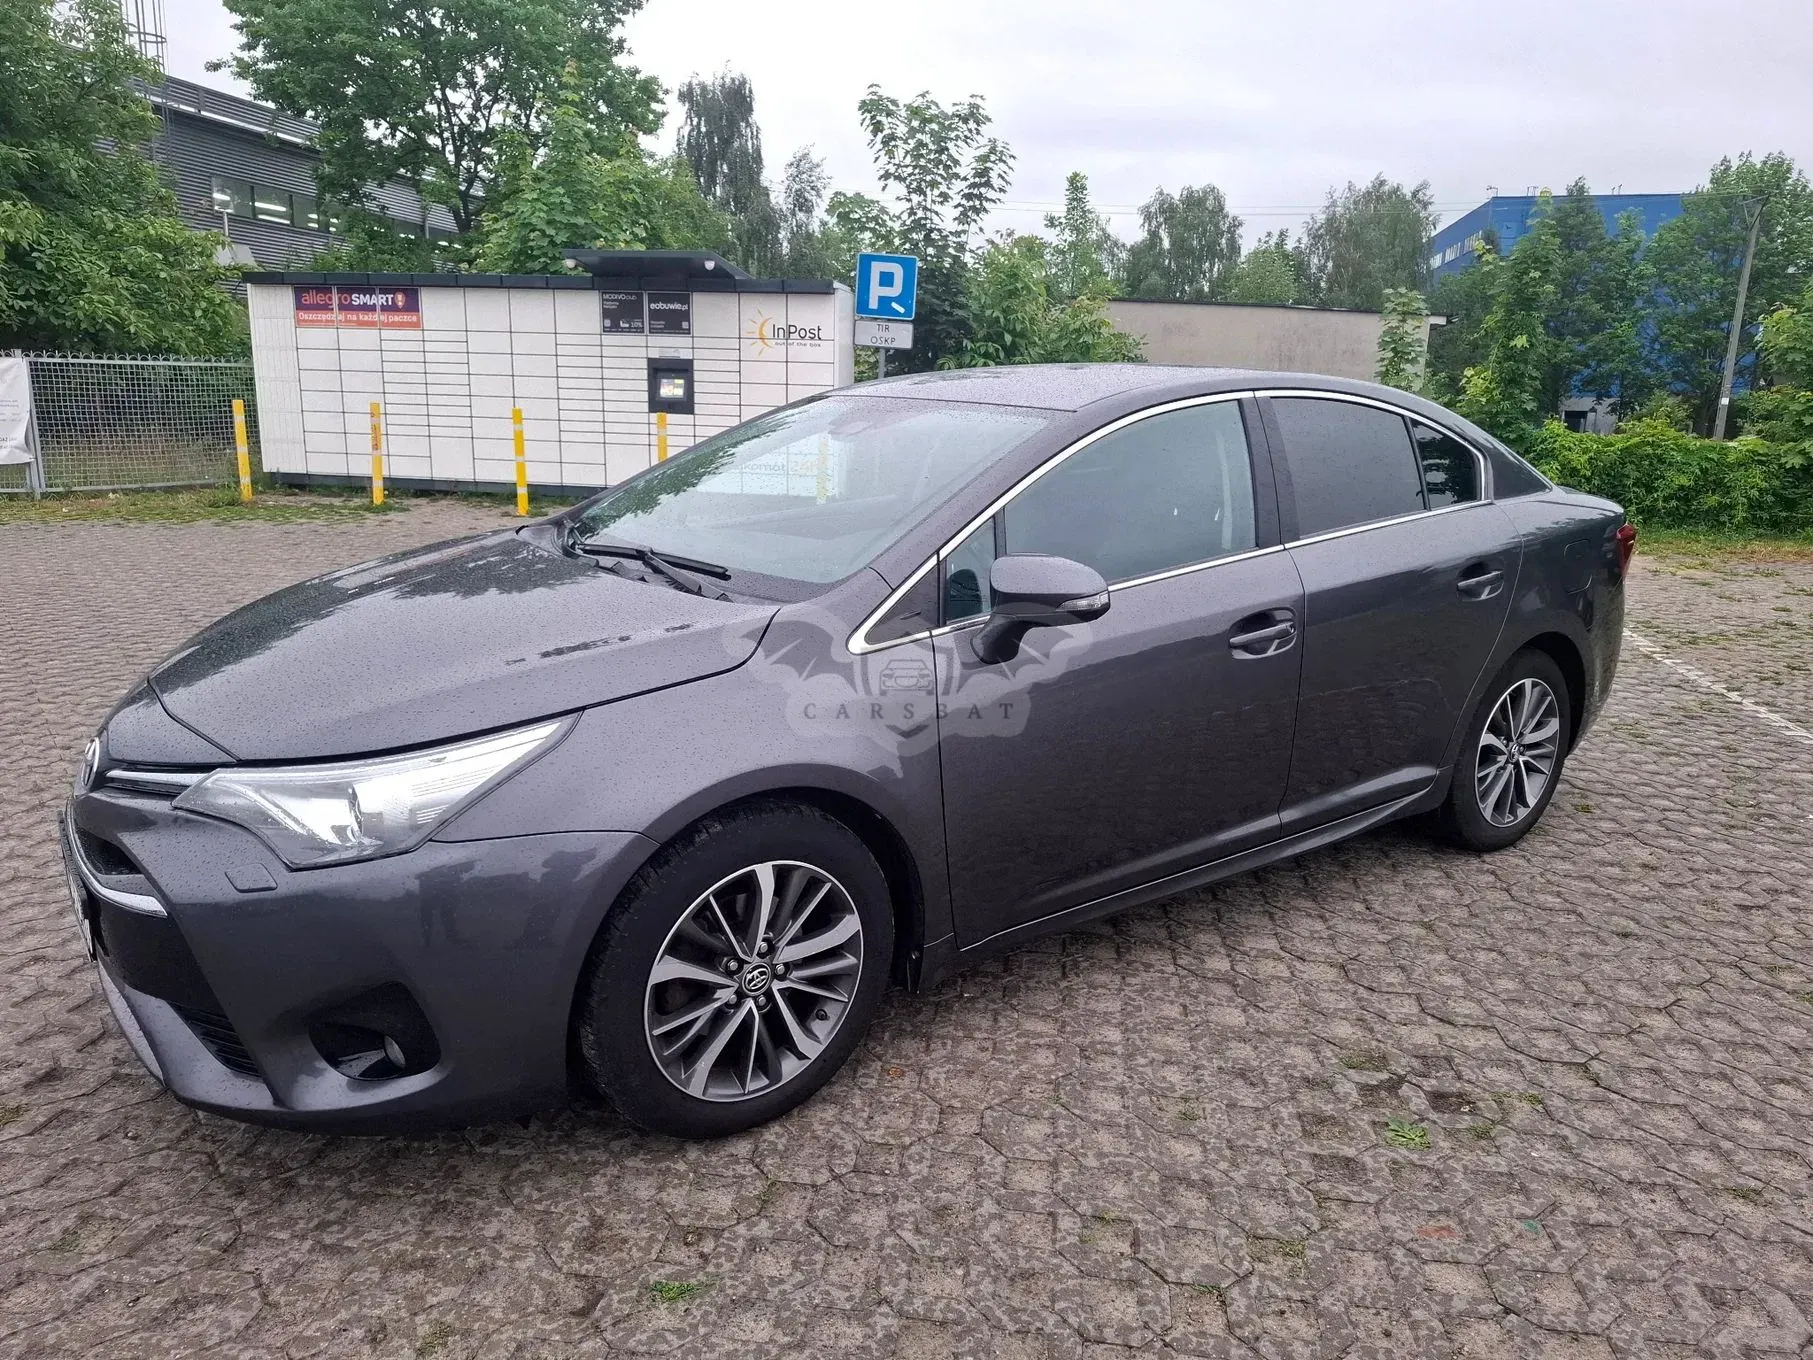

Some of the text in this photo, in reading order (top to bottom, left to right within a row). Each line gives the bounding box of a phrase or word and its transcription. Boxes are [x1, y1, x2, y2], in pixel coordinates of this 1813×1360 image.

[868, 261, 904, 310] P
[301, 289, 394, 308] allegro SMART
[388, 314, 417, 323] paczce
[772, 323, 822, 340] InPost
[876, 323, 890, 333] TIR
[870, 336, 896, 345] OSKP
